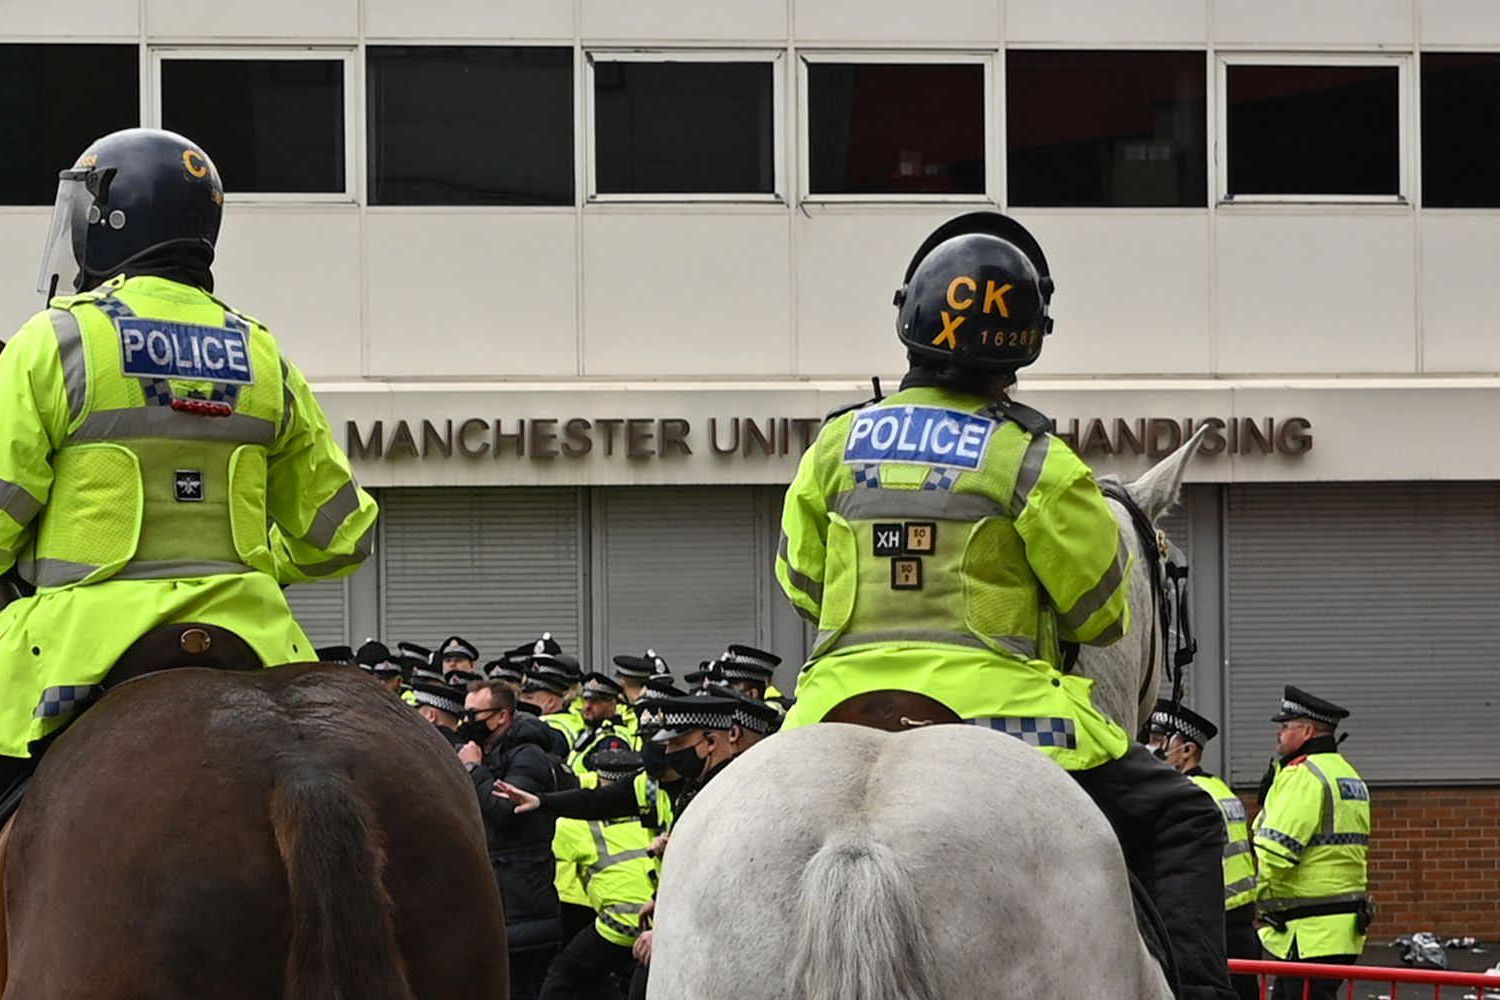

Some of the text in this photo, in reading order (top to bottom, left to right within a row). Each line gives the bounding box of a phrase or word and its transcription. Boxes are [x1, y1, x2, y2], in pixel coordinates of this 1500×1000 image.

[122, 328, 249, 373] POLICE
[931, 310, 967, 350] X
[345, 416, 1314, 459] MANCHESTER UNIT HANDISING
[847, 415, 986, 459] POLICE
[876, 530, 900, 549] XH
